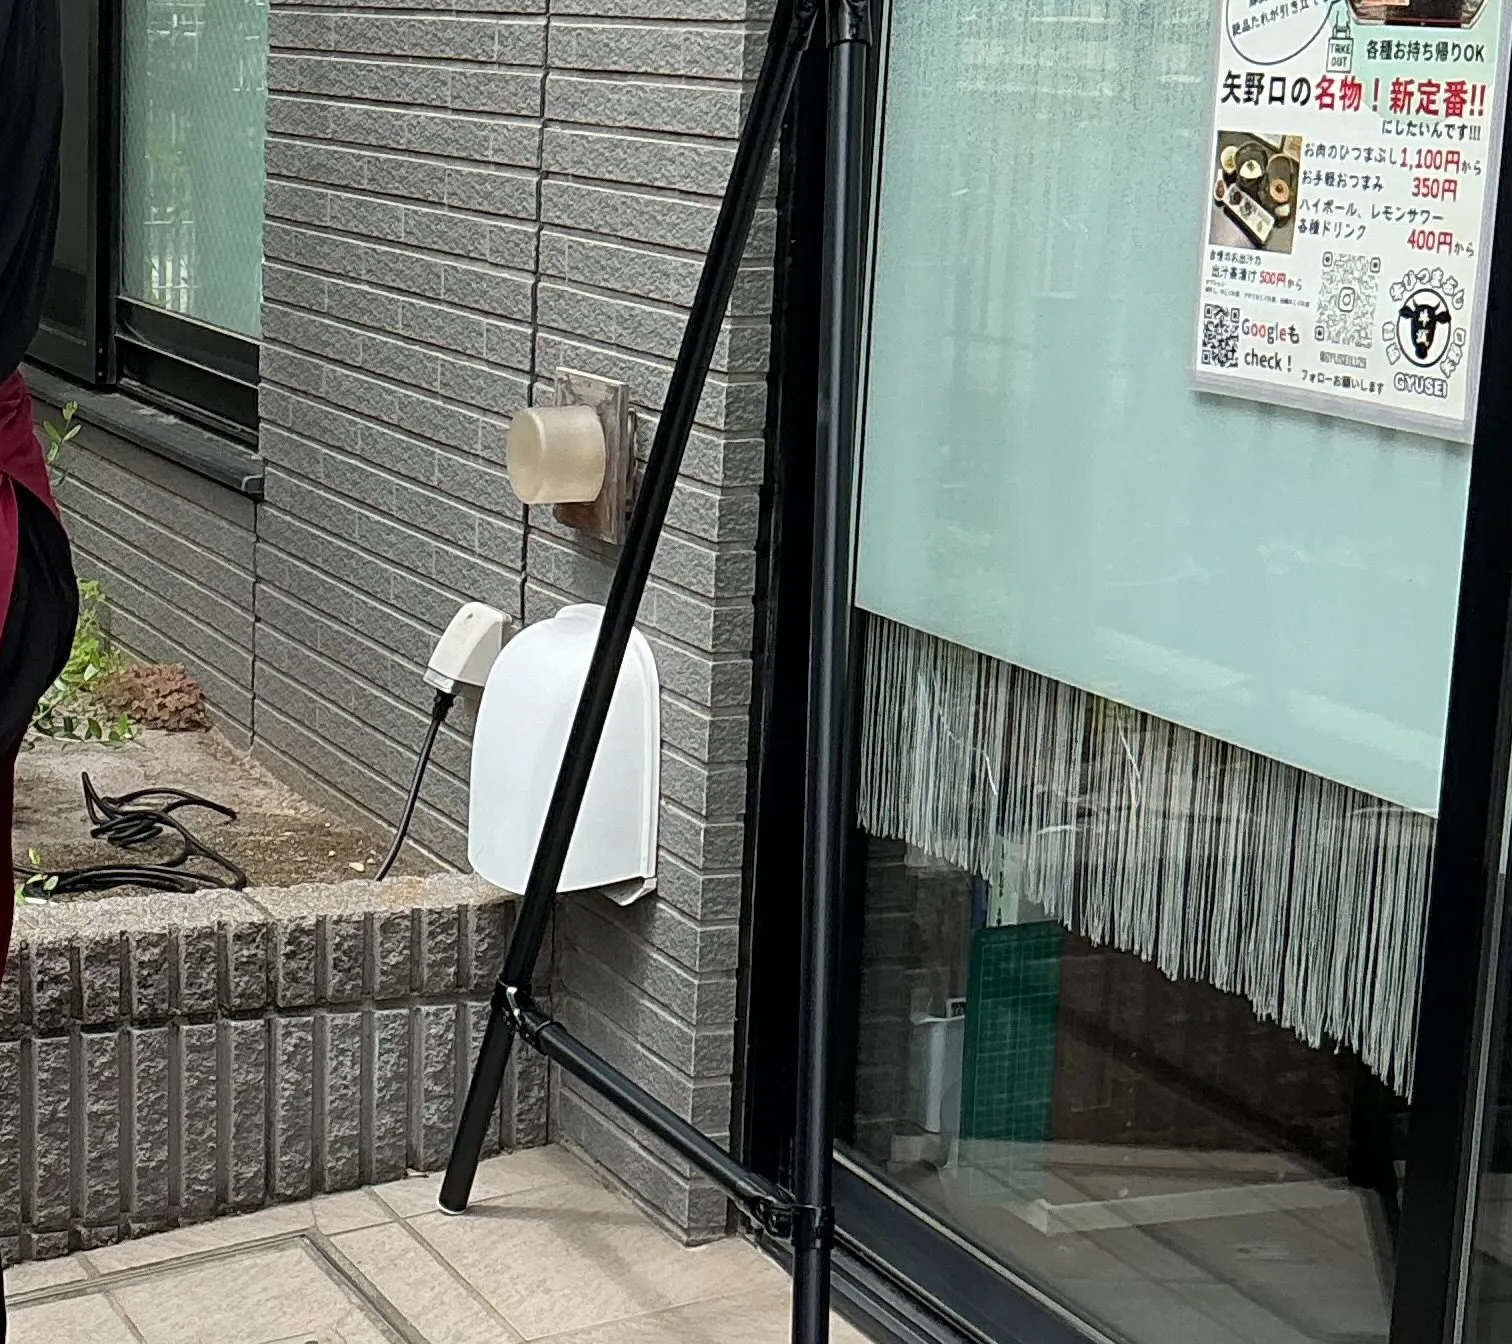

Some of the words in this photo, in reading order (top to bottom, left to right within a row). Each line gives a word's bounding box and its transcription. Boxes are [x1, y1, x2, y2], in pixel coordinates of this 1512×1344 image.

[1330, 43, 1351, 55] TAKE
[1366, 39, 1485, 63] 各種お持ち帰りOK
[1330, 57, 1348, 68] OUT
[1303, 142, 1396, 167] お肉のひつまぶし
[1411, 176, 1458, 202] 350円
[1241, 317, 1300, 345] Googleも
[1393, 371, 1449, 400] GYUSEI
